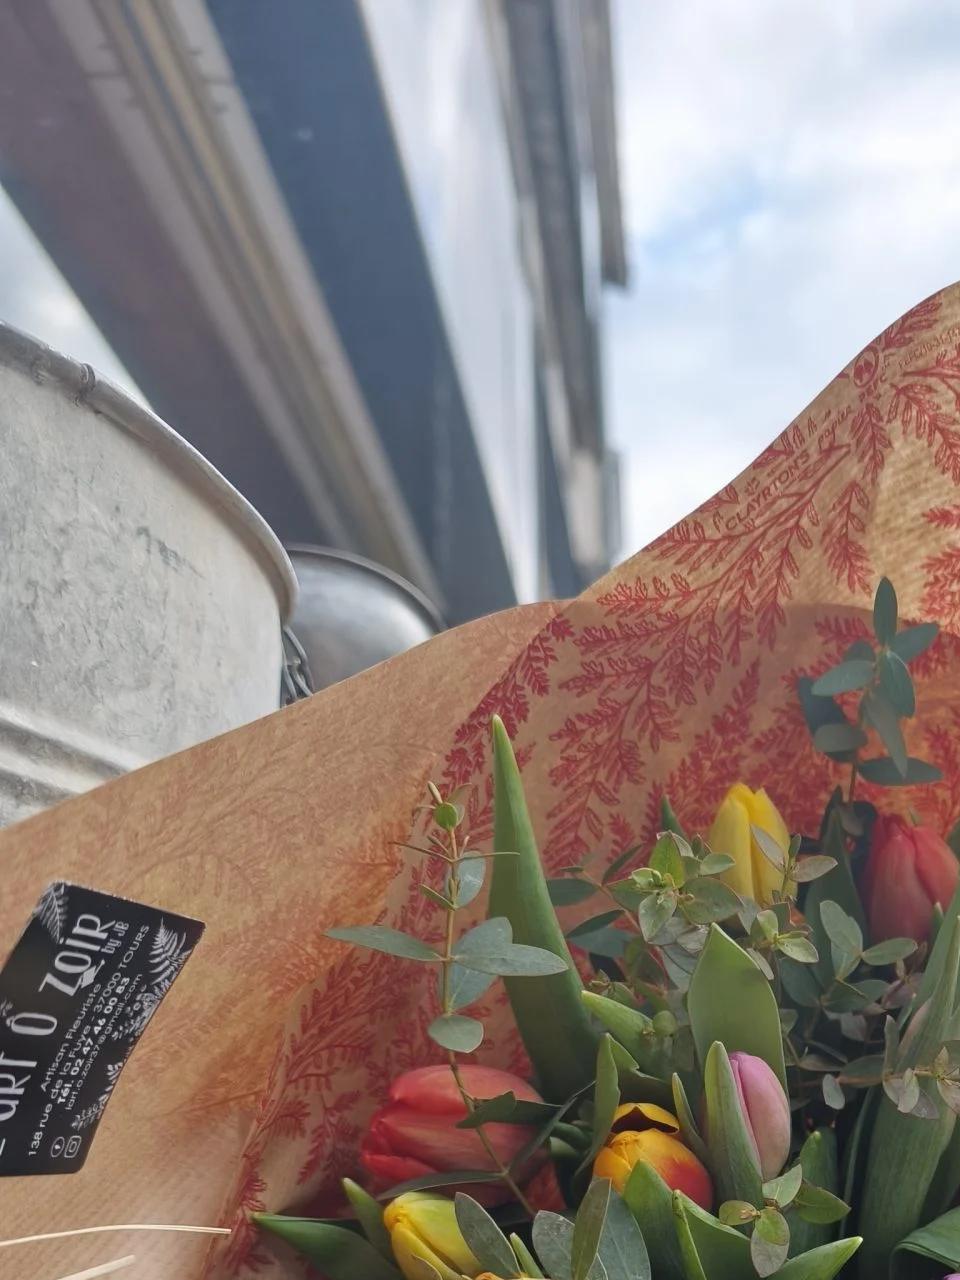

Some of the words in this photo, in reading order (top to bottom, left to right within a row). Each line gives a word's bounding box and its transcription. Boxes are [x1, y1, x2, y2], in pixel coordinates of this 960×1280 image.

[100, 939, 122, 954] by
[113, 921, 130, 937] JB
[28, 1131, 43, 1156] 138
[39, 1103, 53, 1128] rue
[51, 1079, 63, 1099] de
[59, 1061, 72, 1075] la
[68, 1025, 91, 1058] Fuye
[93, 972, 121, 1013] 37000
[117, 925, 149, 970] TOURS
[40, 1043, 69, 1092] Artisan
[65, 983, 101, 1039] Fleuriste
[57, 1080, 74, 1104] Tél.
[70, 1058, 85, 1075] 02
[82, 1037, 94, 1055] 47
[93, 1018, 106, 1035] 46
[103, 997, 118, 1014] 00
[115, 977, 130, 994] 83
